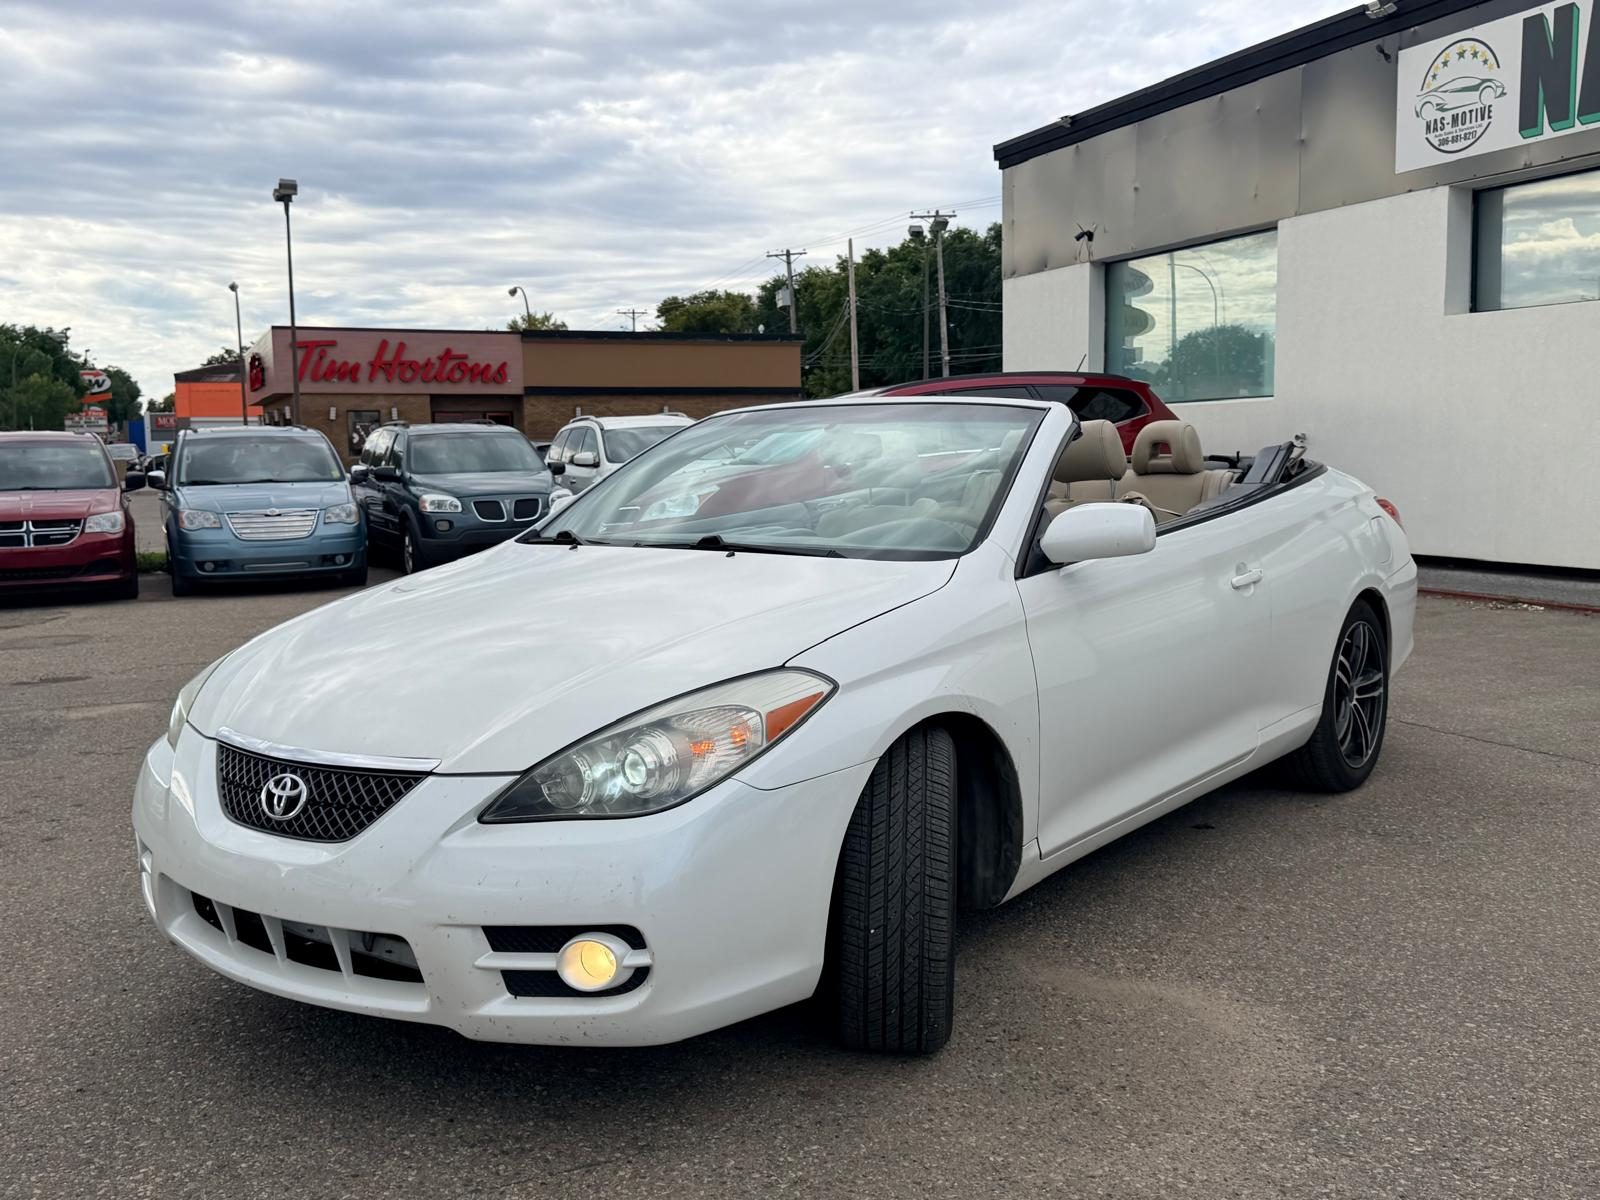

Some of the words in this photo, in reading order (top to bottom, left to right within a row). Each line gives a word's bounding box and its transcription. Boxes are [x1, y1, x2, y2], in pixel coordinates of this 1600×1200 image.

[1425, 104, 1492, 135] NAS-MOTIVE
[290, 340, 360, 382] Tim
[368, 339, 508, 384] Hortons
